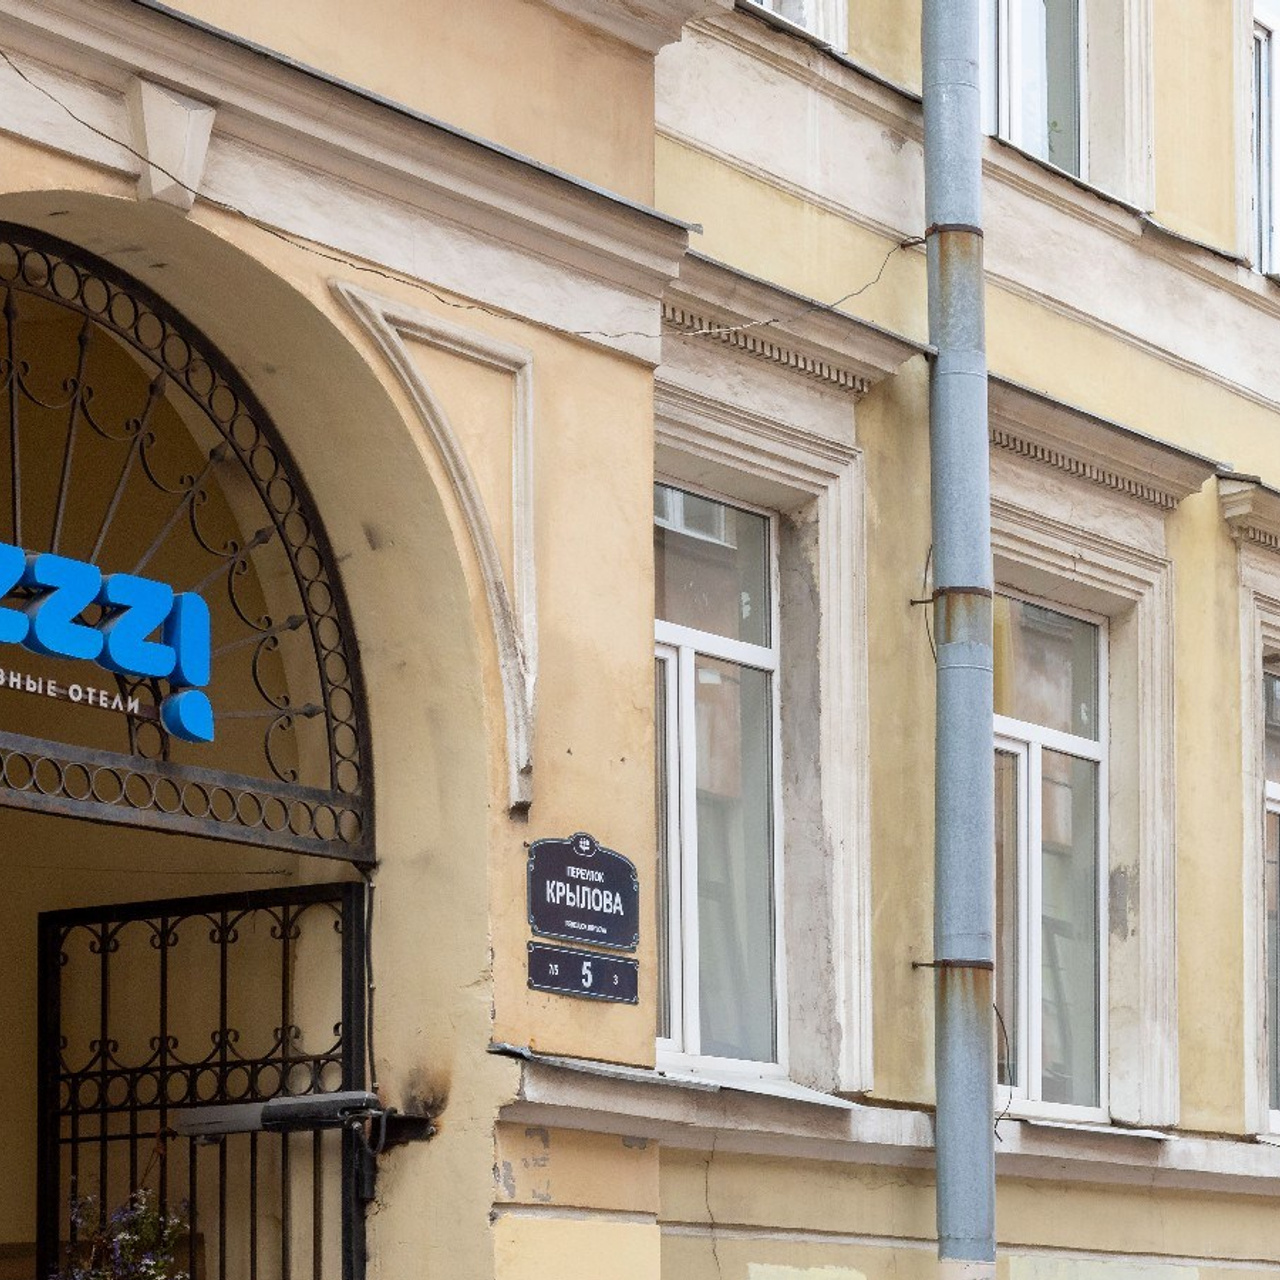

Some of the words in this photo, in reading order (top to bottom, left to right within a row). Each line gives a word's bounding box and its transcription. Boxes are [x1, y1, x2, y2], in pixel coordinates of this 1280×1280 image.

[68, 683, 140, 714] ОТЕЛИ
[567, 865, 605, 883] ПЕРЕУЛОК
[545, 880, 625, 916] КРЫЛОВА
[581, 961, 593, 988] 5
